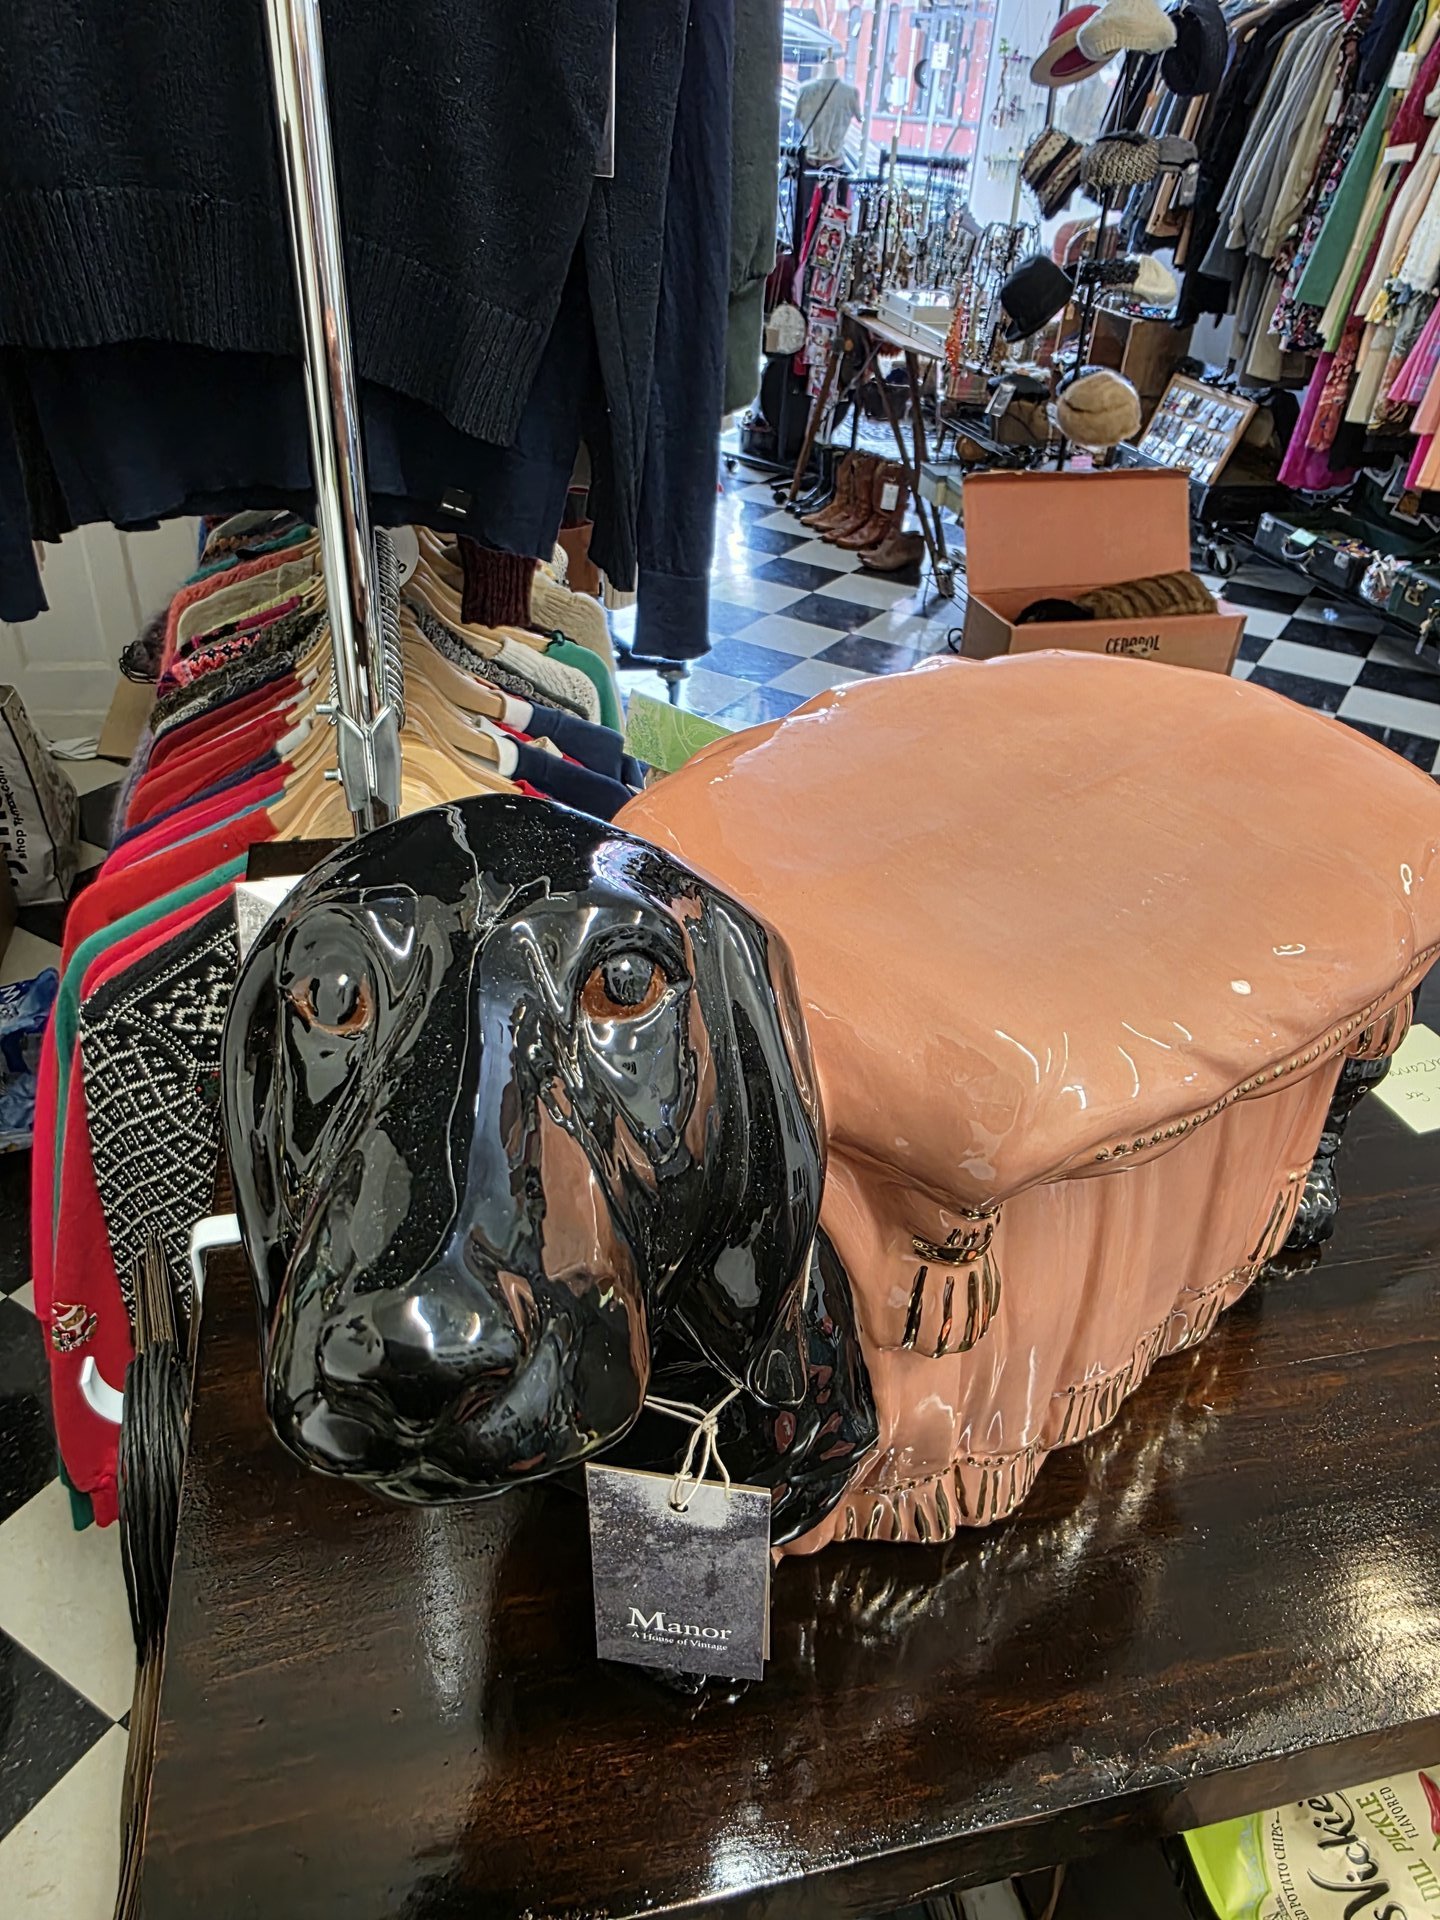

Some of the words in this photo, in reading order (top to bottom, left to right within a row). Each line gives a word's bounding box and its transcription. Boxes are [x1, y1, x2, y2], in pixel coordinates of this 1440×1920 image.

[16, 829, 27, 859] shop
[626, 1606, 732, 1640] Manor
[643, 1632, 674, 1644] House
[676, 1638, 688, 1646] of
[690, 1639, 728, 1651] Vintage
[1355, 1791, 1415, 1853] PICKLE
[1380, 1786, 1419, 1839] FLAVORED
[1271, 1823, 1286, 1860] CHIPS
[1278, 1862, 1301, 1909] POTATO
[1408, 1858, 1440, 1902] DILL
